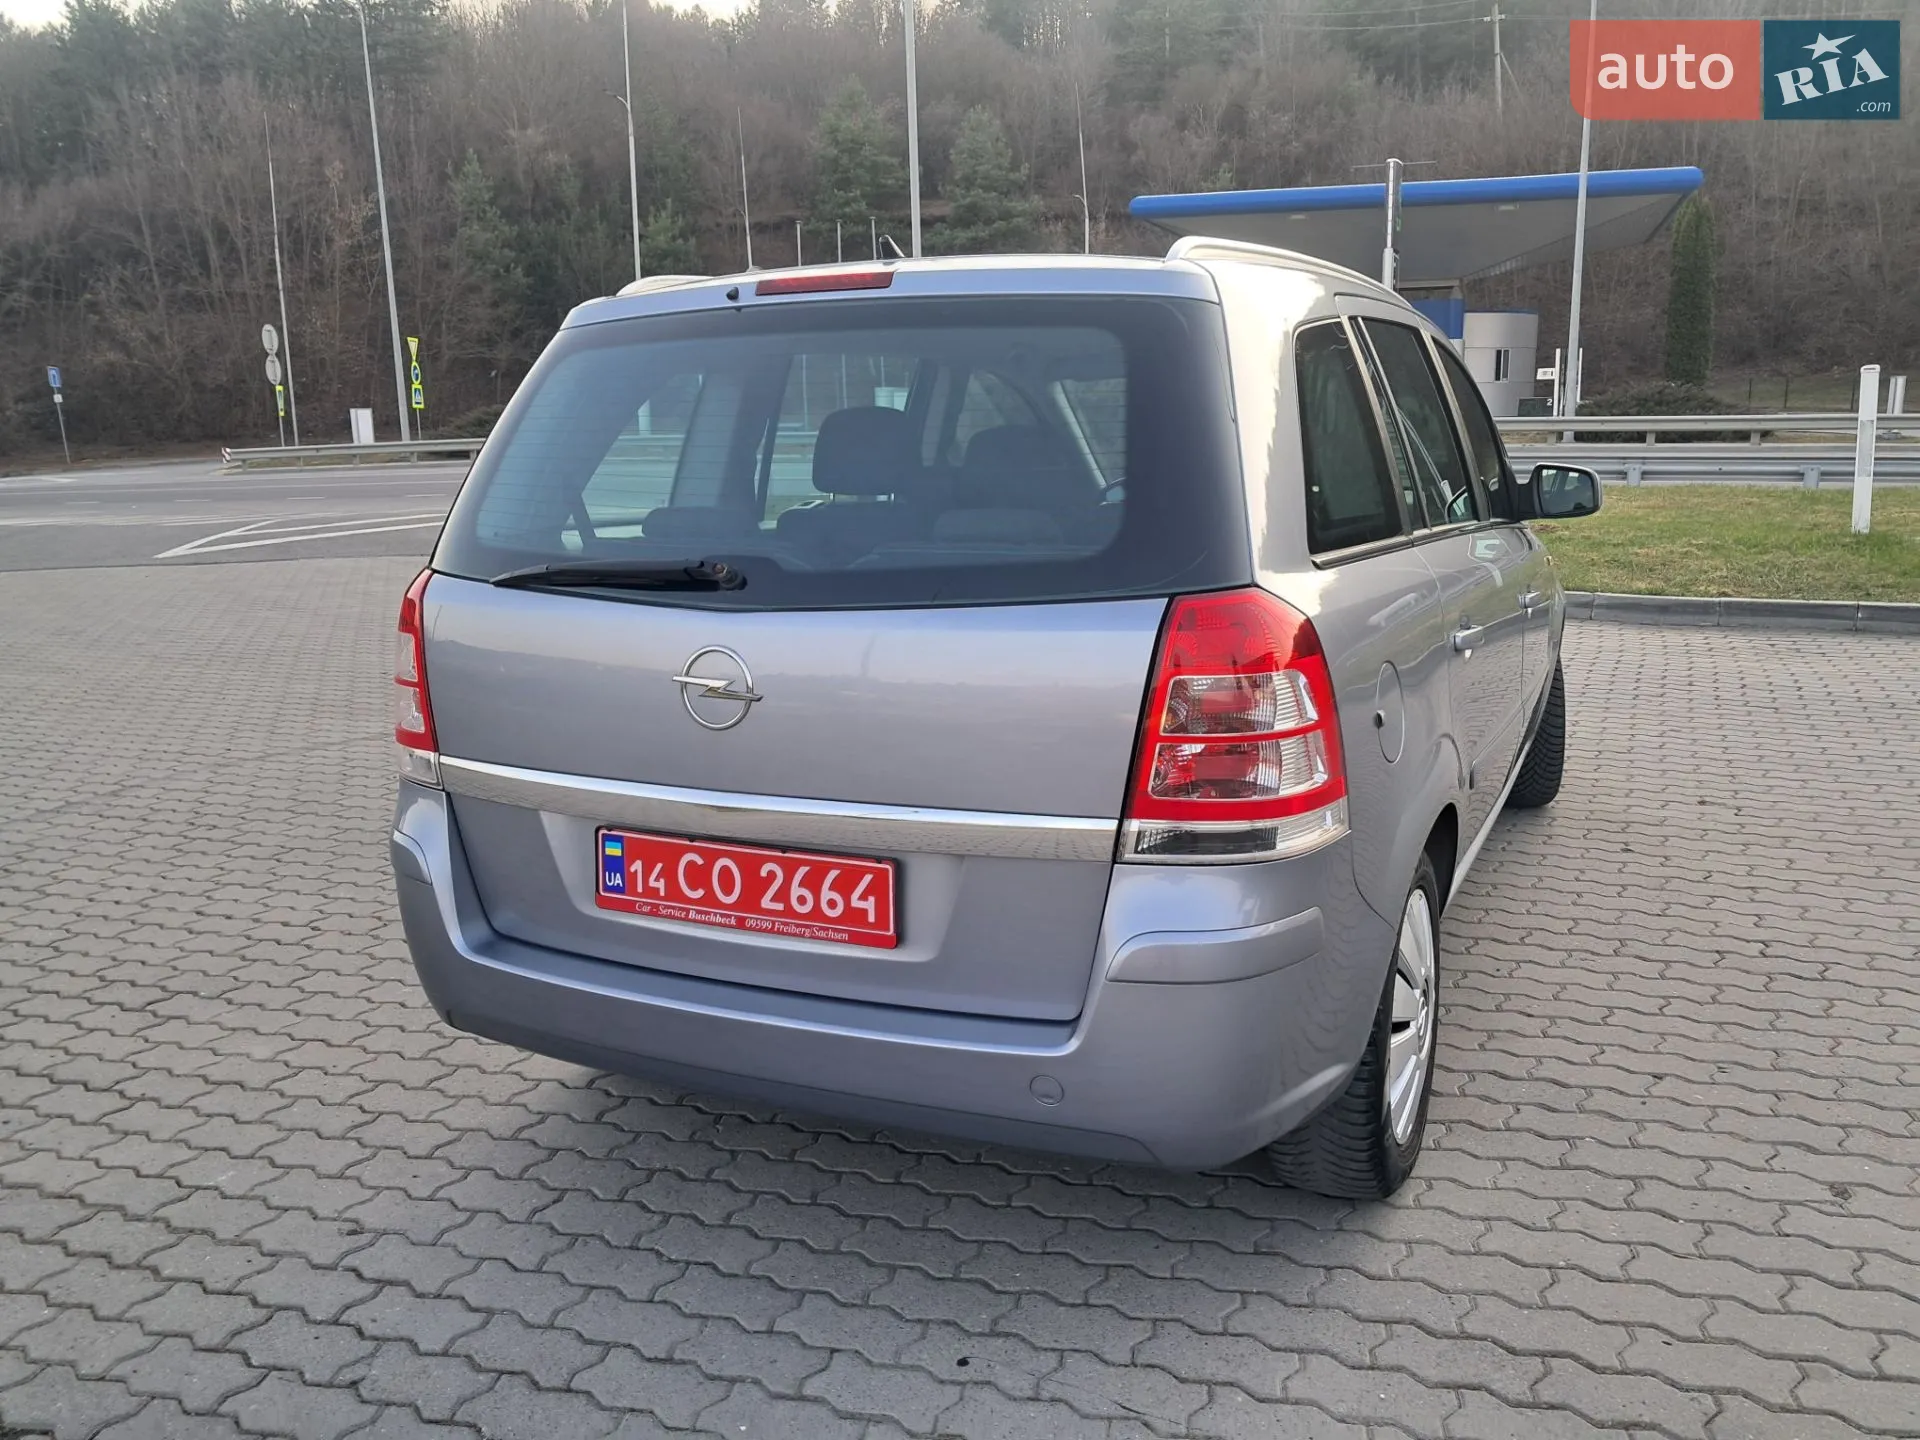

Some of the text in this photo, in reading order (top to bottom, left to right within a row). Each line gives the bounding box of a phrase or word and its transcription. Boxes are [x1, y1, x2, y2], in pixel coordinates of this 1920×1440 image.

[605, 871, 623, 888] UA
[629, 852, 876, 924] 14 CO 2664
[635, 901, 652, 913] Car
[657, 905, 687, 919] Service
[688, 908, 737, 926] Buschbeck
[745, 919, 772, 931] 09599
[774, 921, 849, 941] Freiberg/Sachsen
